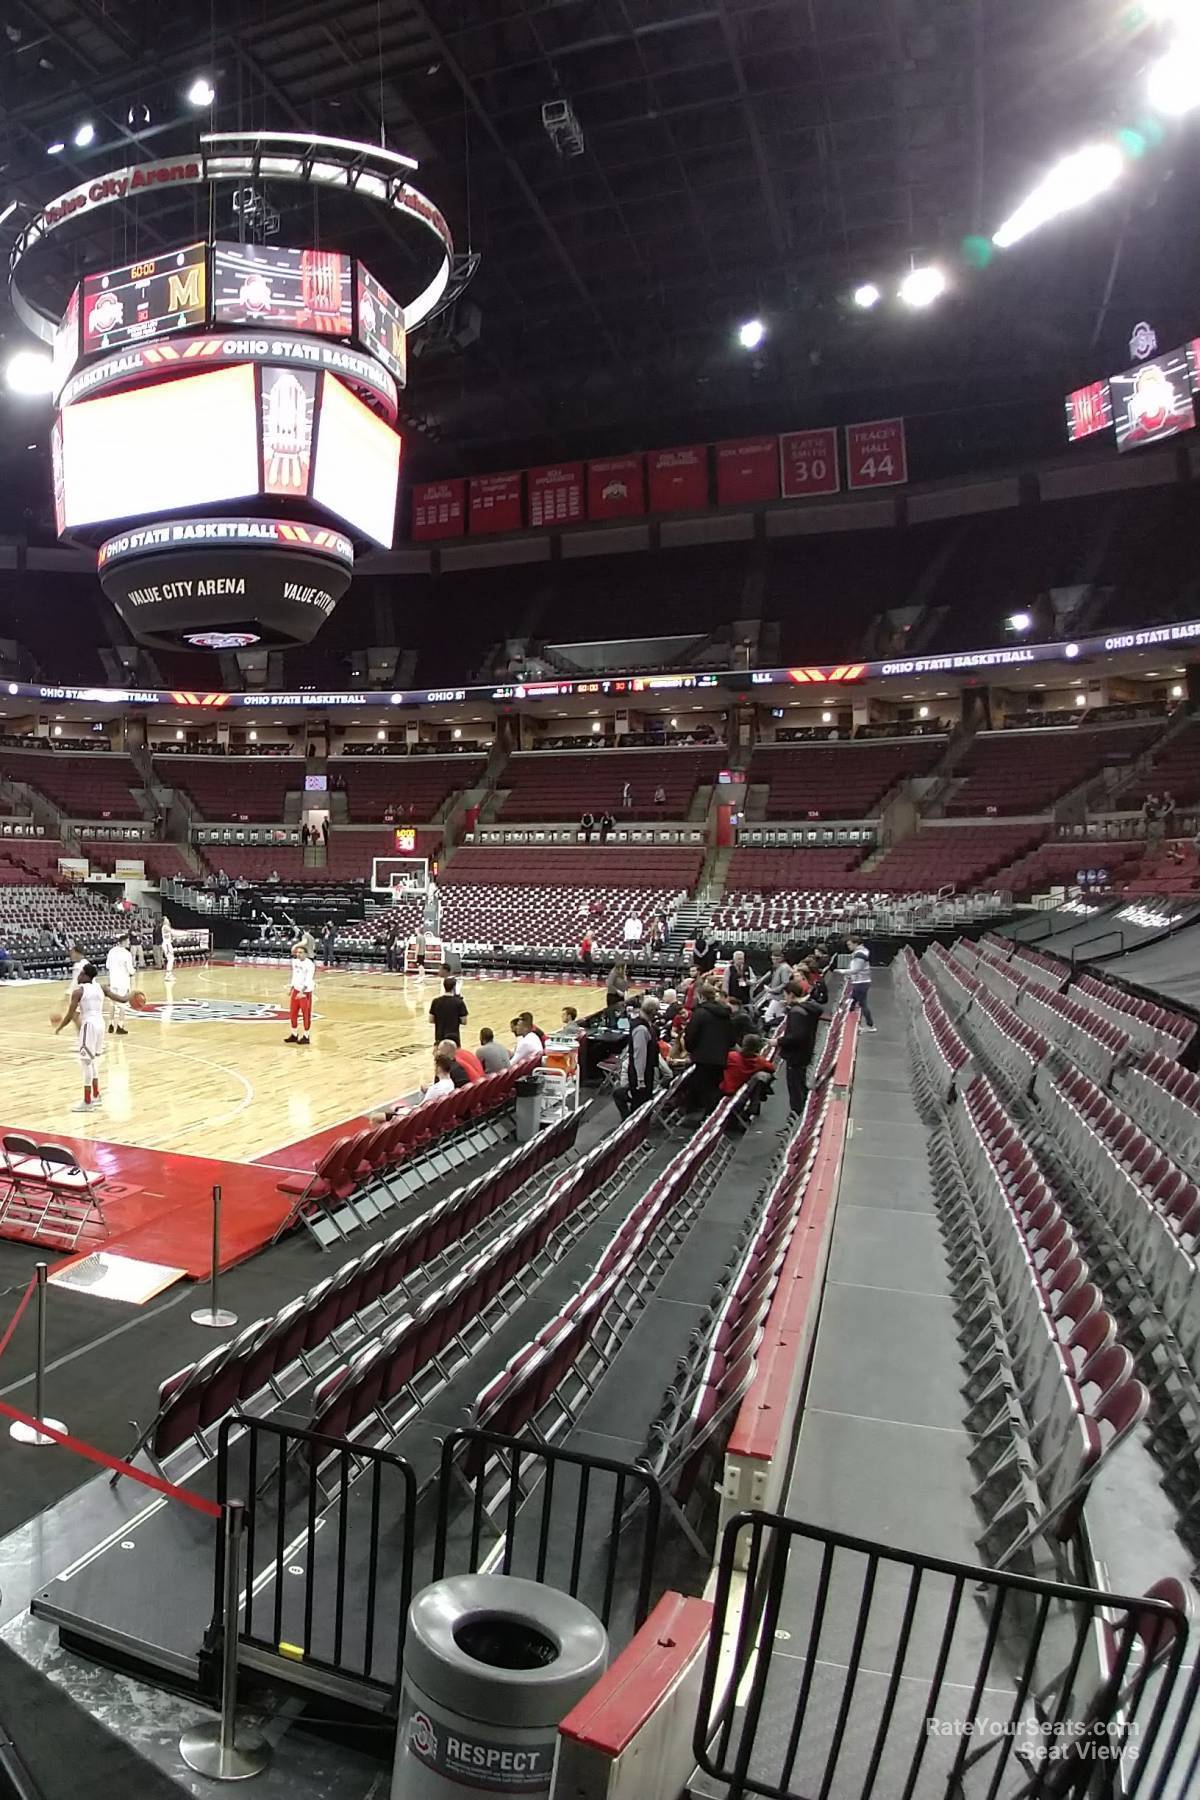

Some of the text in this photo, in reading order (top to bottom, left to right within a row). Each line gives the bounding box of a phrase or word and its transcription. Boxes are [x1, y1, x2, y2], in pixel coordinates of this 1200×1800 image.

[43, 163, 199, 225] Value City Arena
[168, 269, 200, 312] M
[223, 340, 269, 355] OHIO
[271, 341, 319, 361] STATE
[855, 431, 896, 443] TRACEY
[861, 442, 890, 455] HALL
[795, 460, 826, 482] 30
[860, 455, 894, 478] 44
[130, 528, 170, 548] STATE
[172, 523, 278, 540] BASKETBALL
[128, 578, 246, 606] VALUE CITY ARENA
[283, 582, 318, 603] VALUE
[1105, 635, 1134, 649] OHIO
[1136, 629, 1170, 645] STATE
[882, 650, 1034, 675] OHIO STATE BASKETBALL
[40, 687, 64, 698] OHIO
[243, 695, 366, 704] OHIO STATE BASKETBALL
[428, 692, 453, 701] OHIO
[446, 1736, 540, 1771] RESPECT
